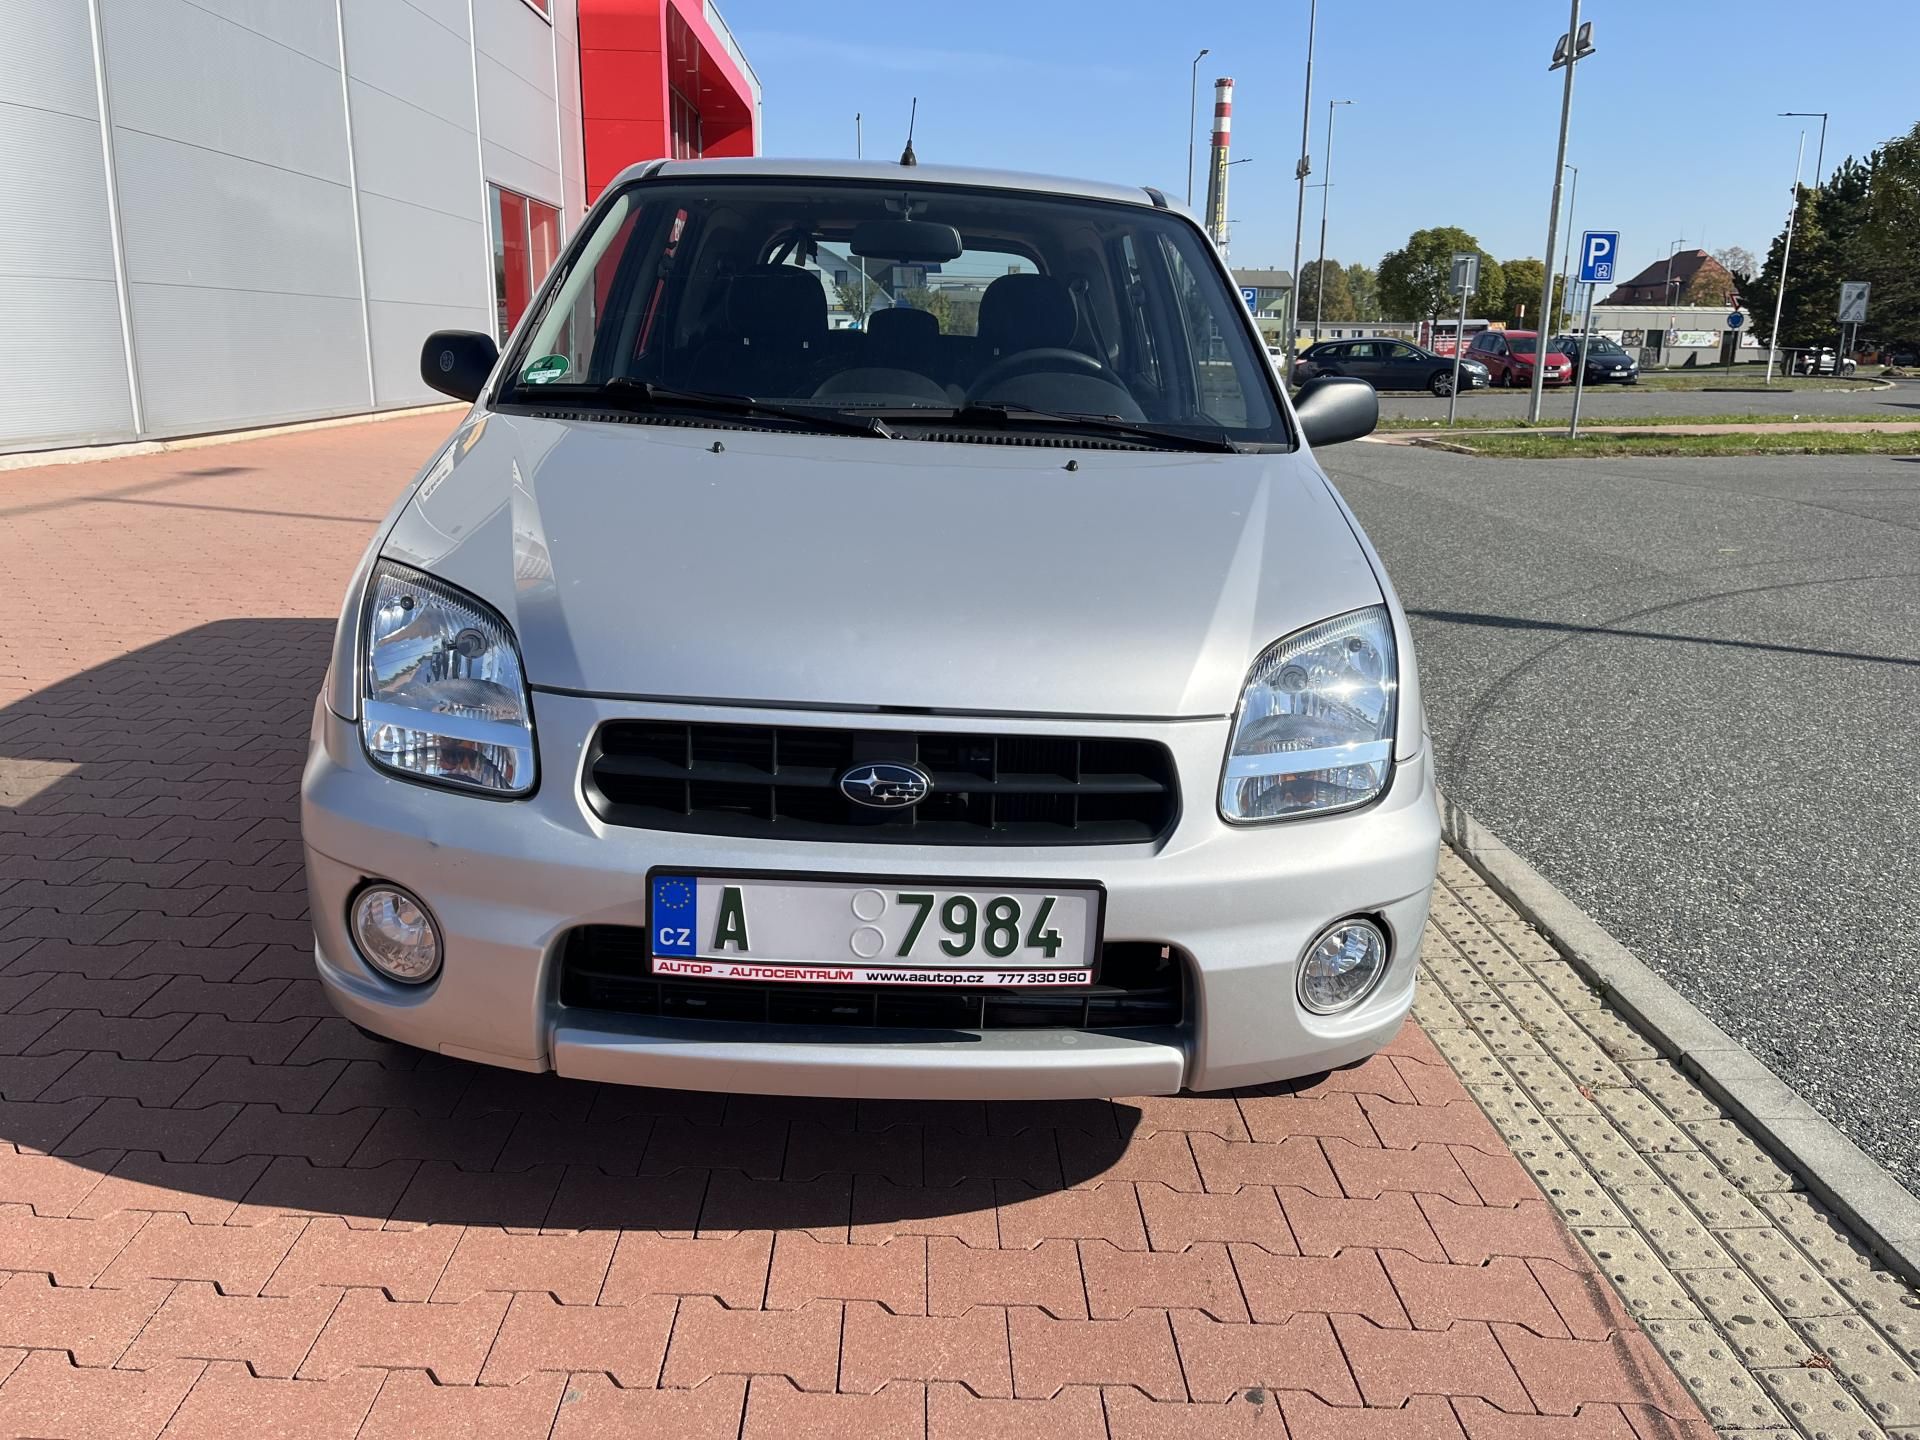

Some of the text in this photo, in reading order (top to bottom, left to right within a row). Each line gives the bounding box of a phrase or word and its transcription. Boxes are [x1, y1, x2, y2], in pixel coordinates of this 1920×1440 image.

[1588, 237, 1610, 267] P
[713, 885, 1063, 959] A 7984
[659, 927, 691, 946] CZ
[658, 961, 713, 974] AUTOP
[729, 967, 853, 980] AUTOCENTRUM
[866, 972, 984, 985] www.aautop.cz
[997, 973, 1025, 983] 777
[1027, 973, 1056, 983] 330
[1058, 972, 1087, 983] 960
